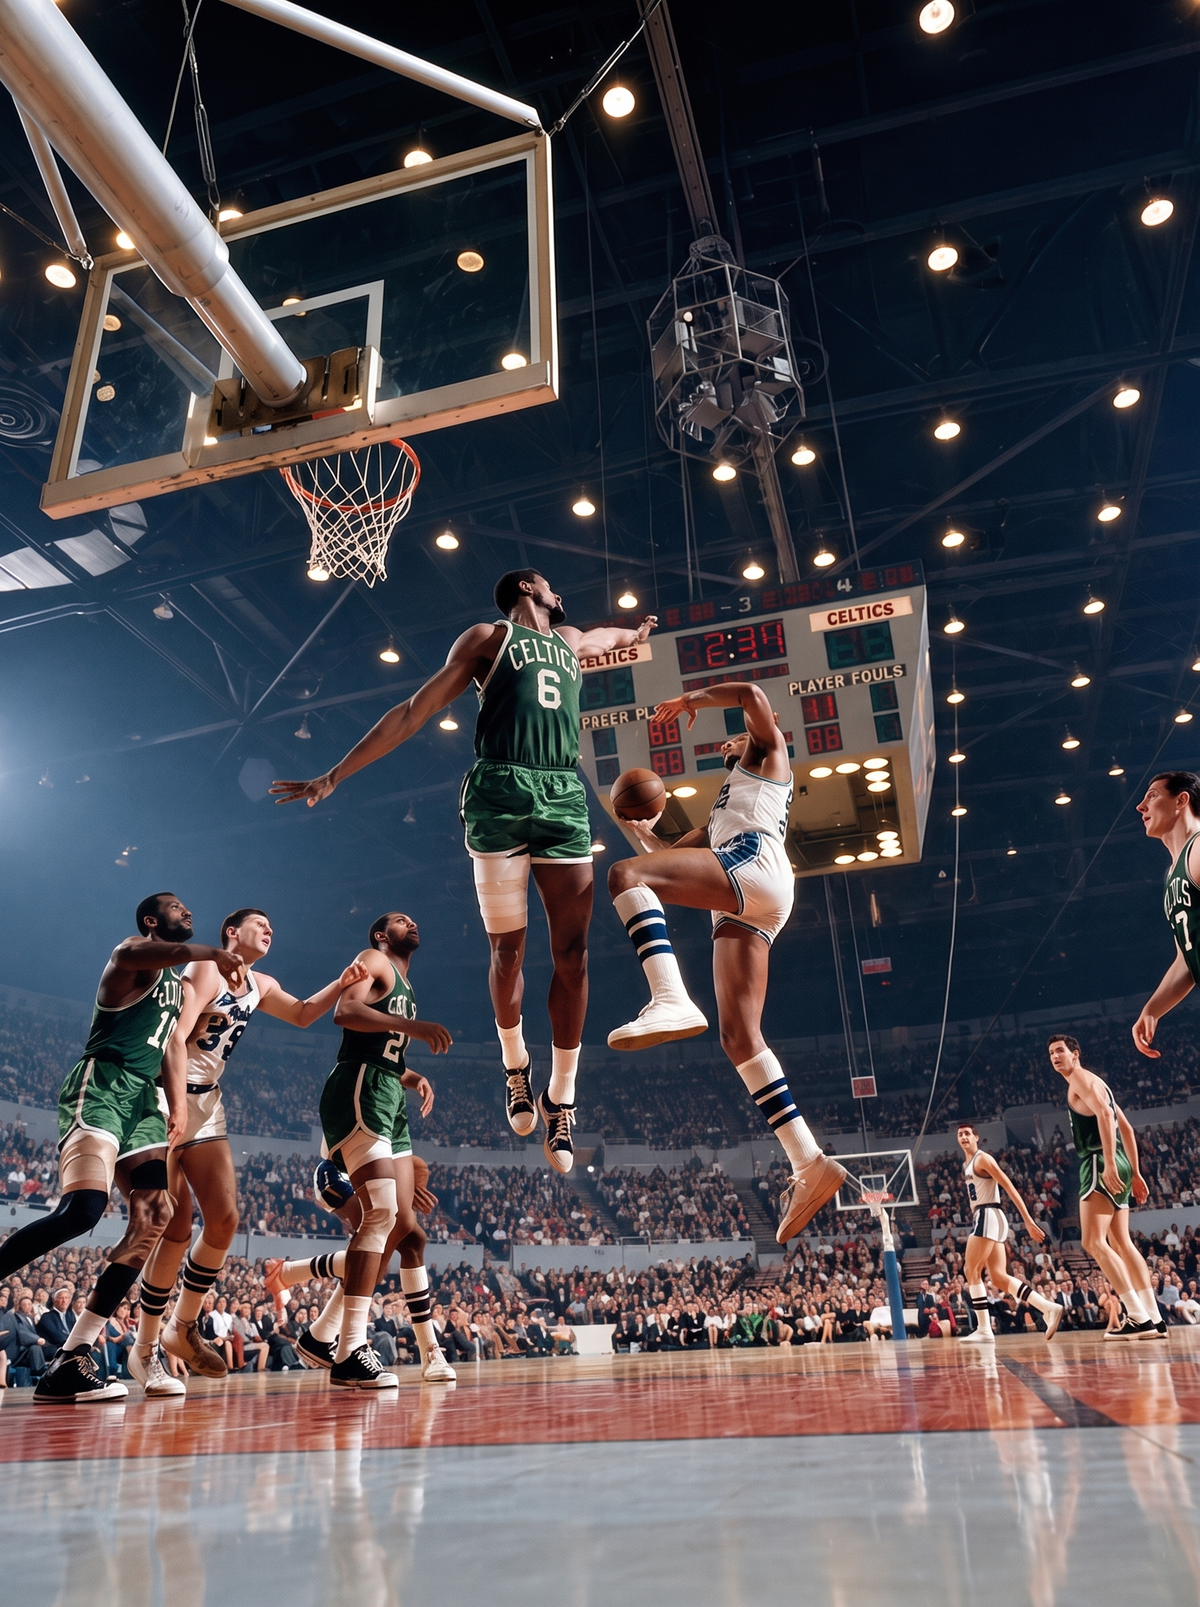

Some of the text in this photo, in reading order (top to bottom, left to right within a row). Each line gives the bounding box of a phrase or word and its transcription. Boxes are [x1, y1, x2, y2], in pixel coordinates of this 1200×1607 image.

[836, 577, 853, 593] 4
[827, 602, 894, 626] CELTICS
[508, 638, 579, 682] CELTICS
[537, 668, 561, 710] 6
[788, 674, 845, 696] PLAYER
[851, 664, 904, 685] FOULS
[1171, 910, 1193, 951] 7
